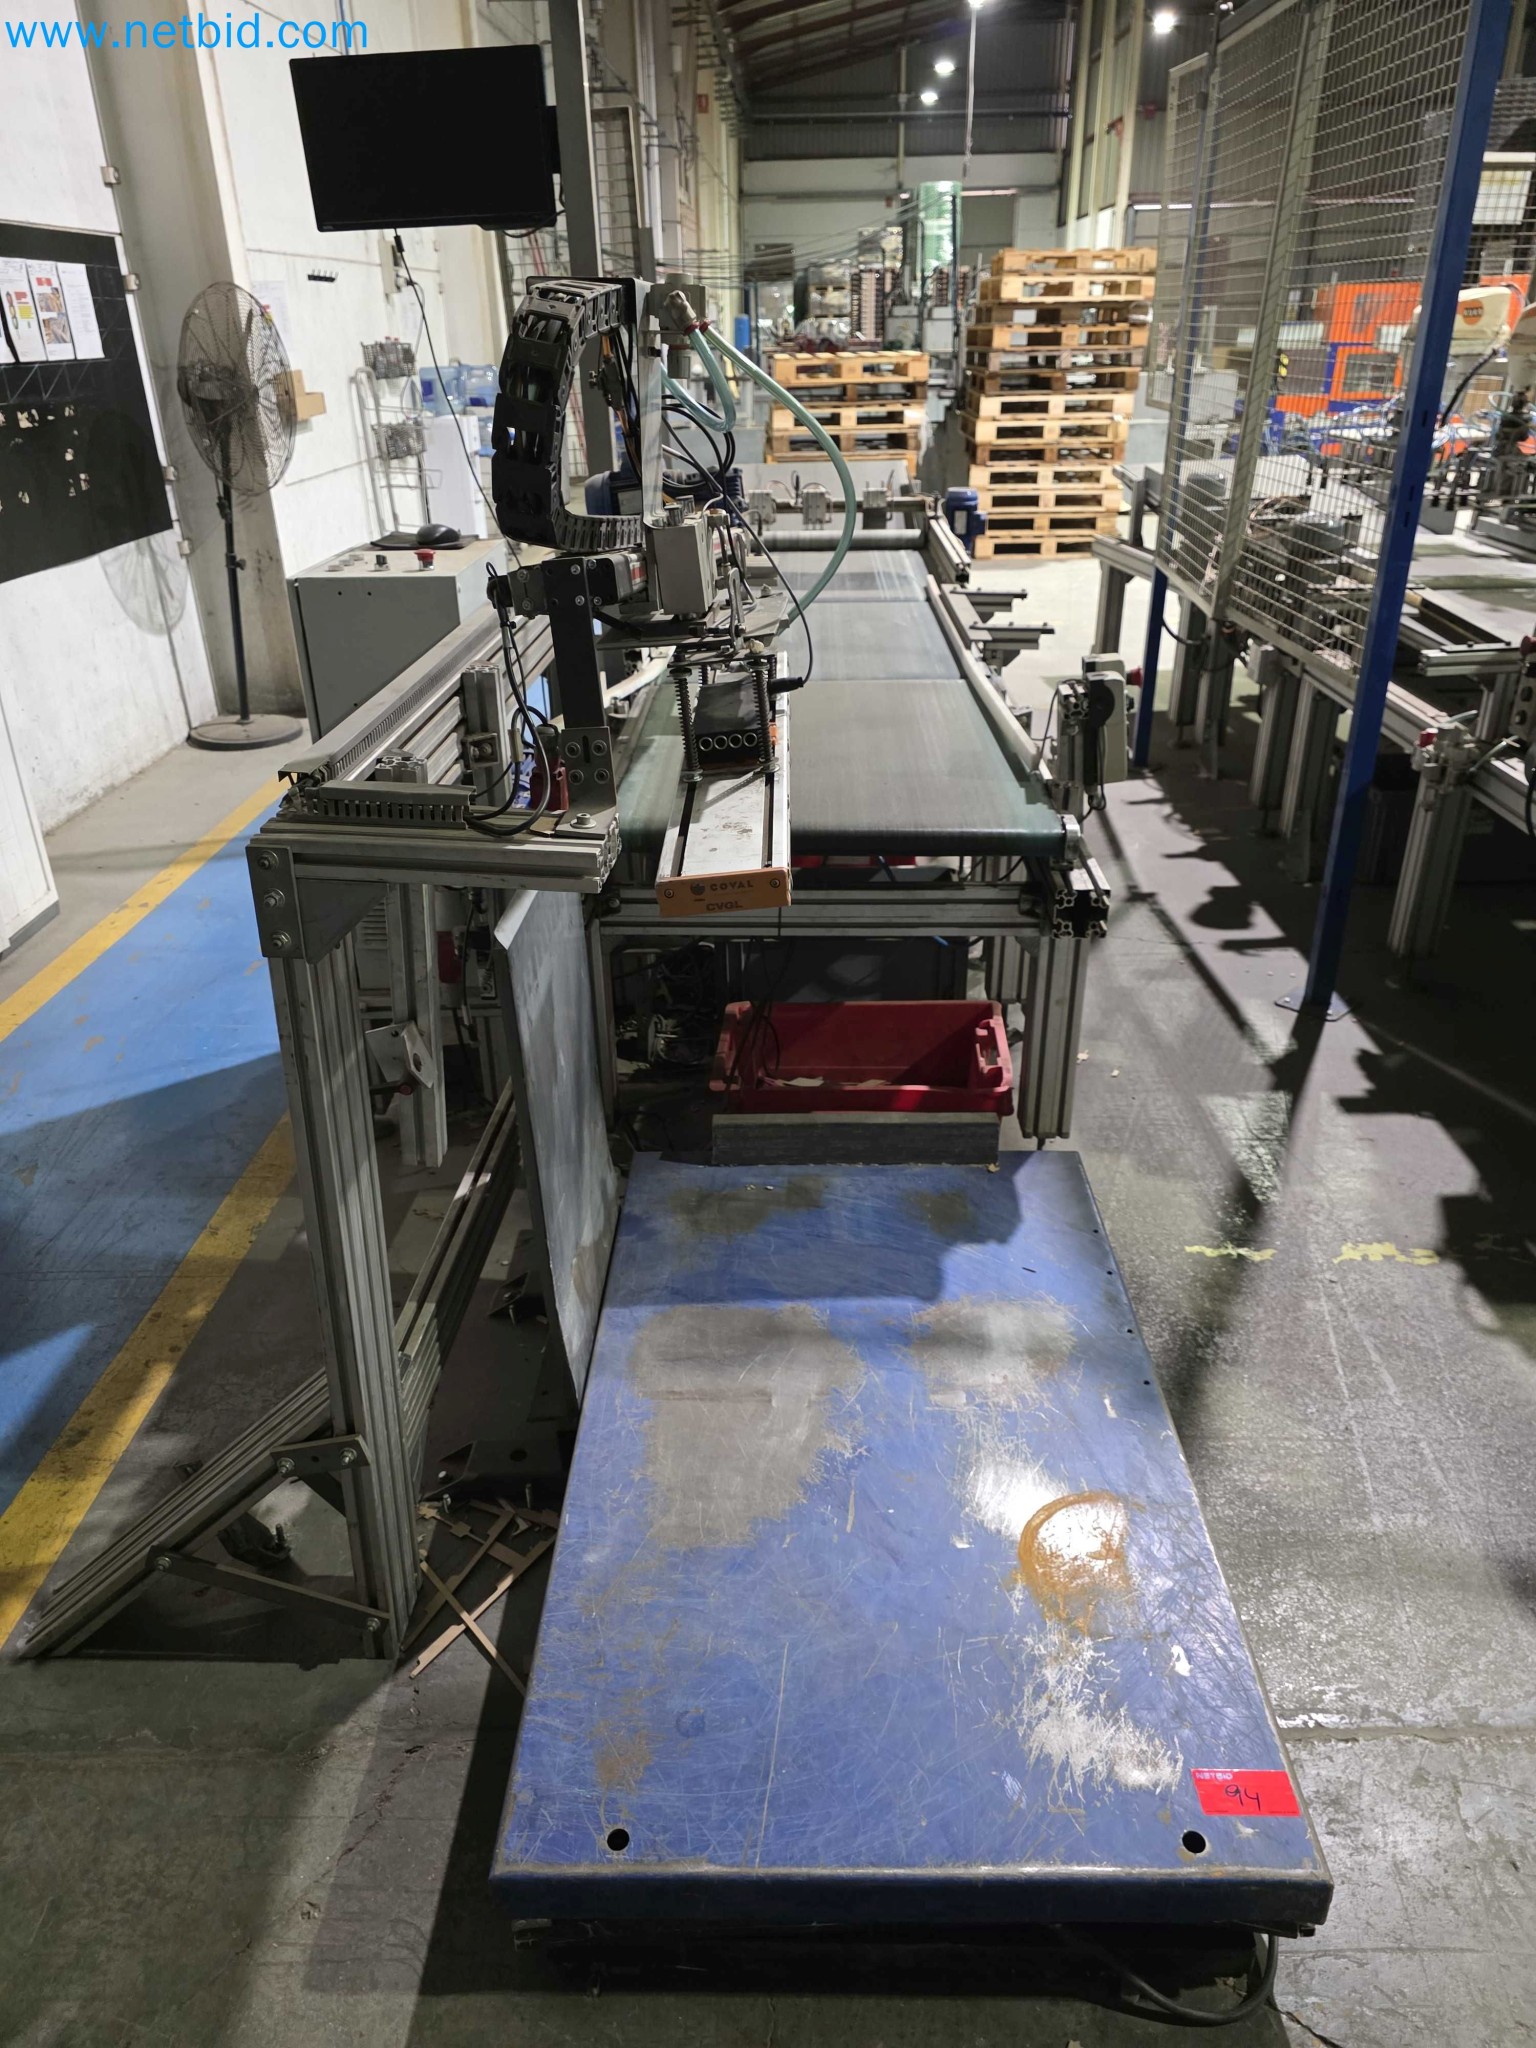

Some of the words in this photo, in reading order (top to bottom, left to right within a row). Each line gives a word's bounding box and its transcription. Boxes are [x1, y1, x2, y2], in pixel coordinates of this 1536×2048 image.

[710, 880, 754, 892] COVAL
[706, 901, 743, 911] CVGL
[1225, 1784, 1261, 1811] 94
